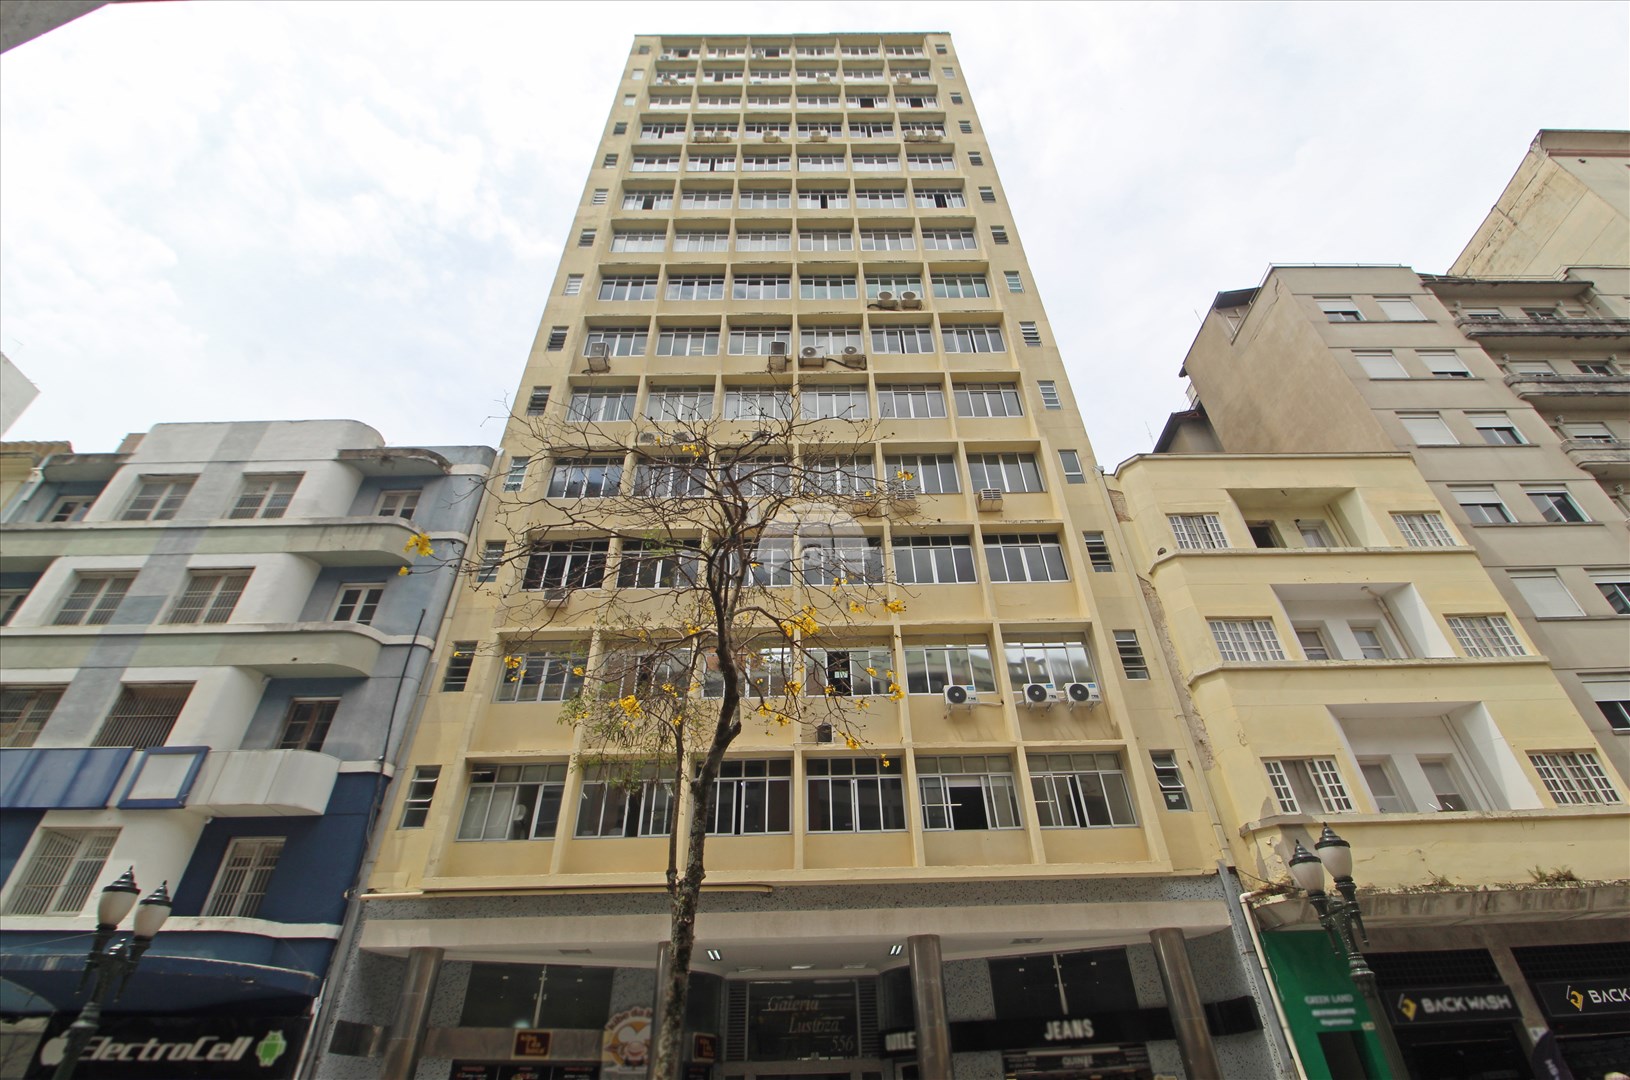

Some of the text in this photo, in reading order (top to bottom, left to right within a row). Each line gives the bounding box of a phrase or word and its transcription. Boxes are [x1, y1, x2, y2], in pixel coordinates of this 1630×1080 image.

[1421, 993, 1513, 1014] BACK WASH
[1587, 987, 1630, 1004] BACK
[788, 1014, 841, 1034] Lustoza
[1043, 1018, 1095, 1041] JEANS
[831, 1035, 855, 1053] 556
